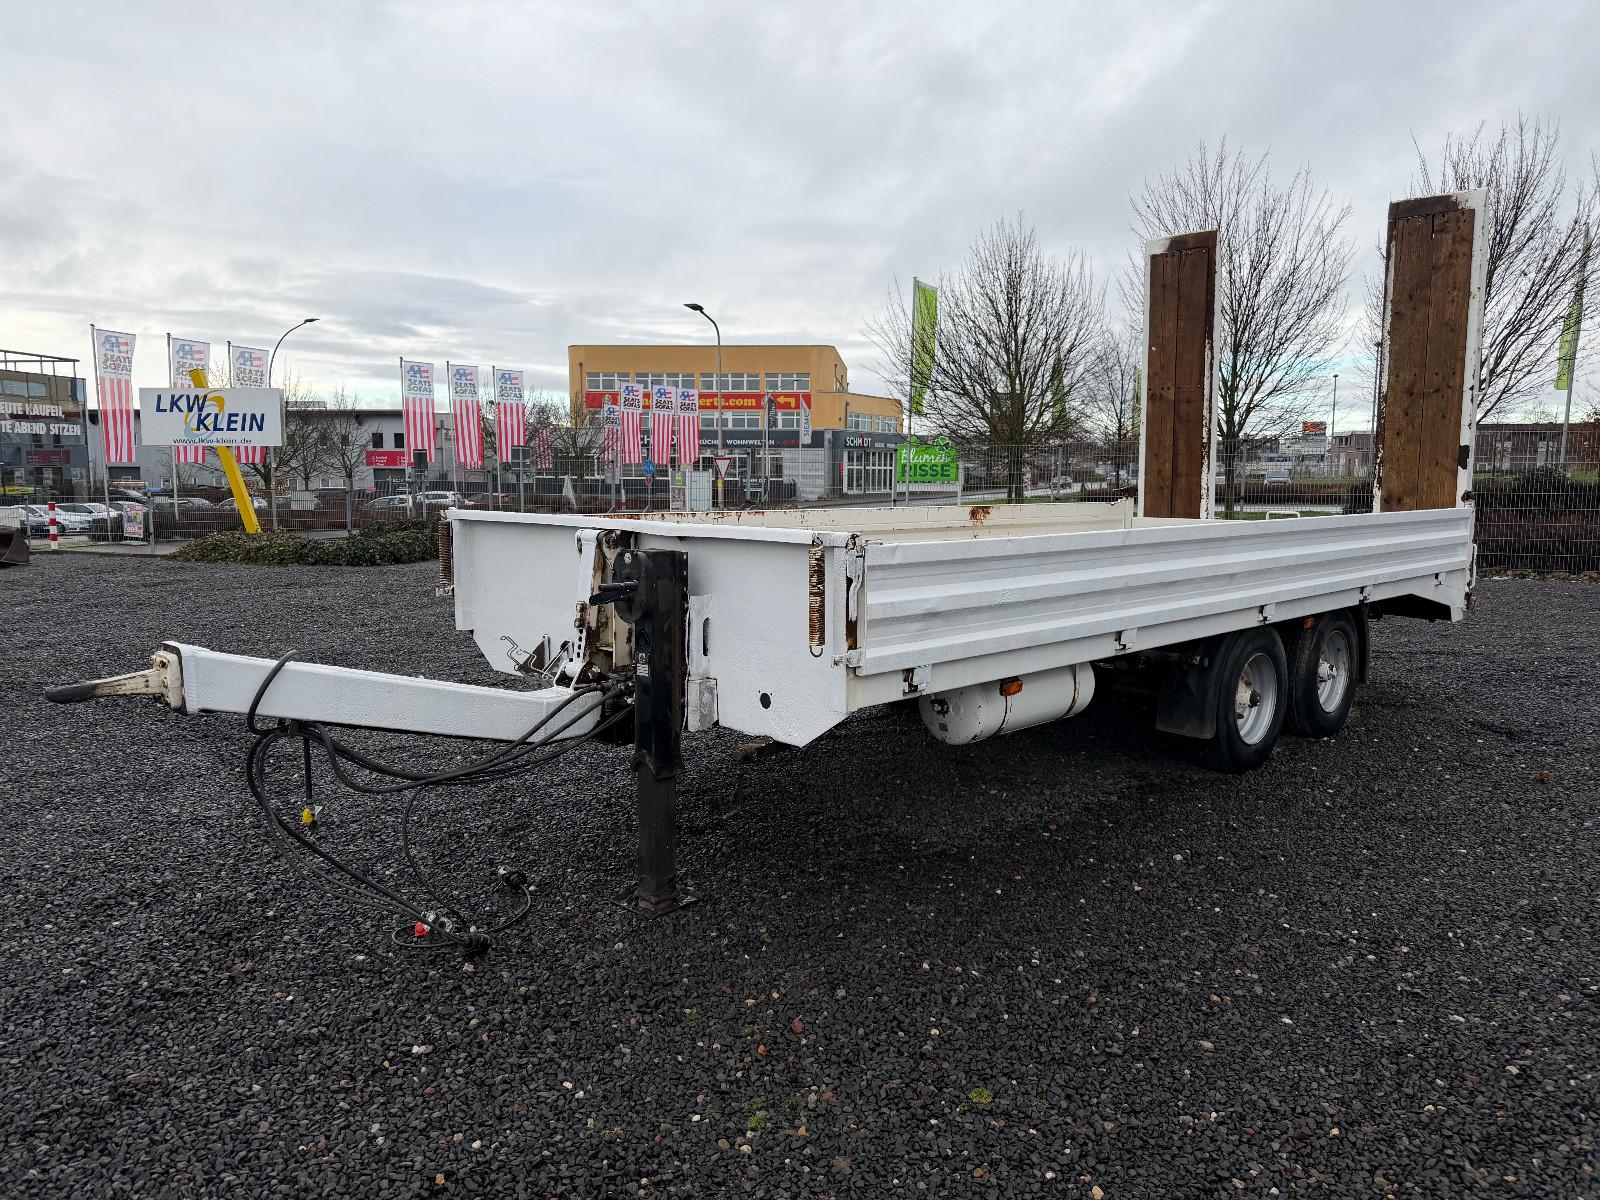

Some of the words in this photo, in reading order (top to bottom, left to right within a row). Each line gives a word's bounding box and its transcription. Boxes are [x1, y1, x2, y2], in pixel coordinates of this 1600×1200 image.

[237, 367, 264, 377] SEATS
[407, 385, 432, 393] SOFAS
[408, 379, 431, 387] SEATS
[155, 393, 208, 413] LKW
[624, 396, 641, 404] SEATS
[14, 421, 47, 435] ABEND
[49, 423, 81, 436] SITZEN
[195, 412, 265, 431] KLEIN
[845, 434, 872, 448] SCHMIDT
[901, 447, 951, 464] Blumen
[901, 463, 951, 478] RISSE
